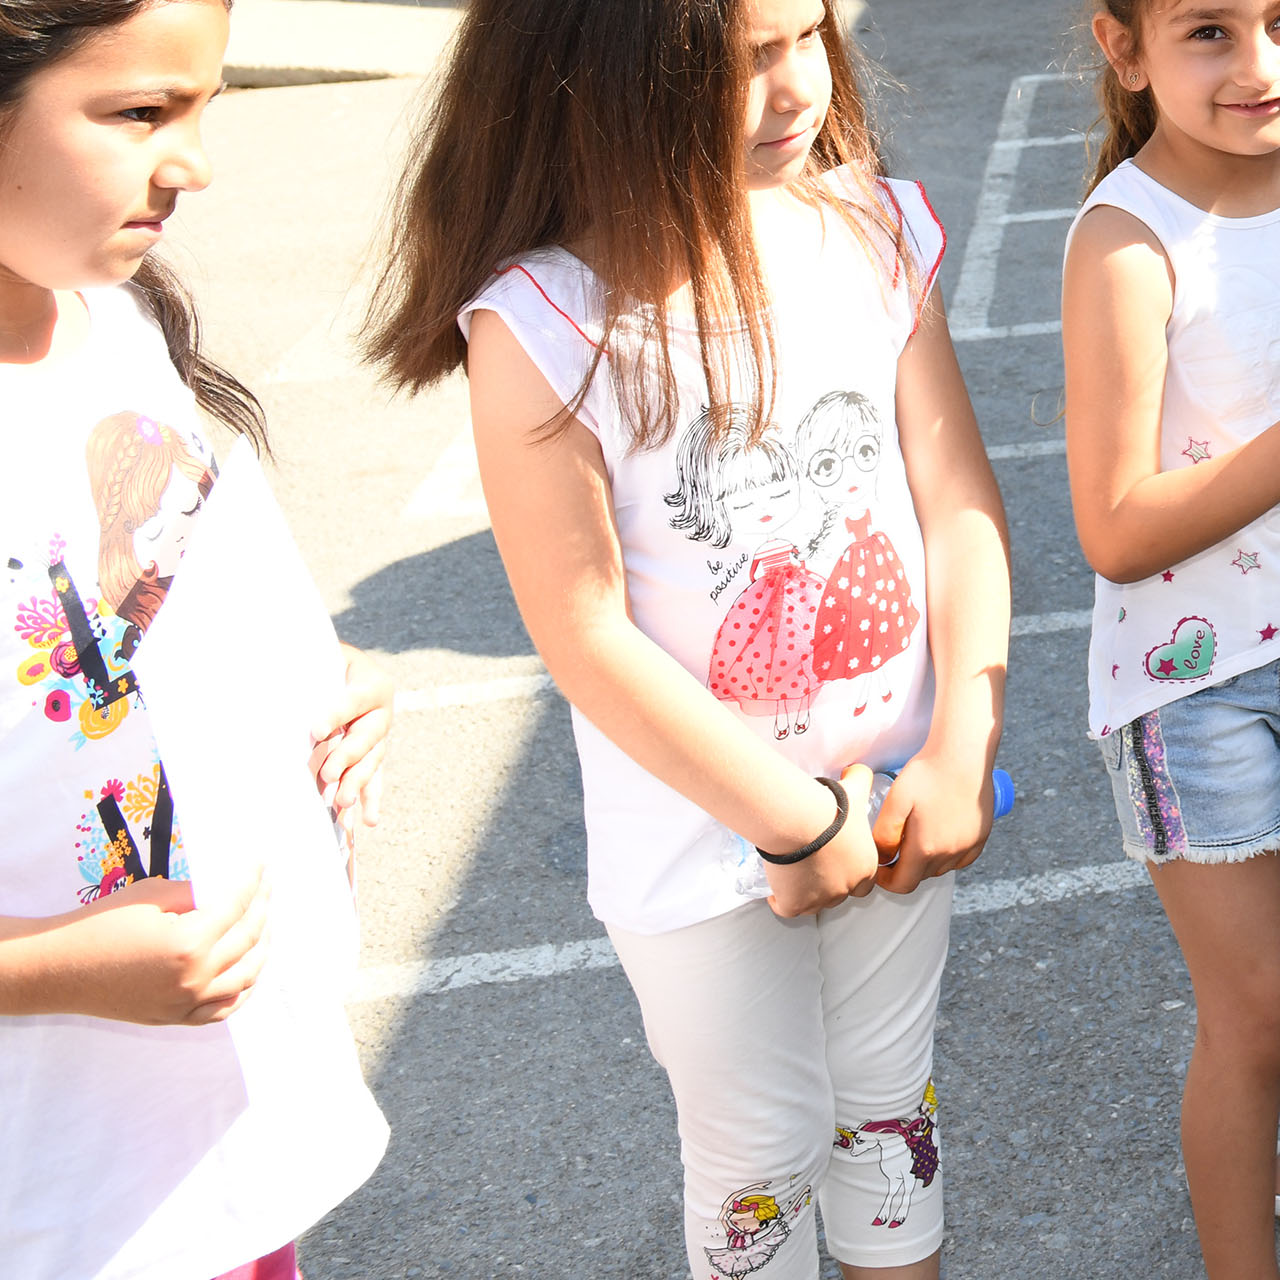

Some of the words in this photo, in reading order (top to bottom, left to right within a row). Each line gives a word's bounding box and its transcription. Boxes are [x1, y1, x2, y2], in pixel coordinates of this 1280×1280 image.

[706, 560, 724, 576] be
[709, 552, 749, 607] positive
[1183, 629, 1206, 670] love
